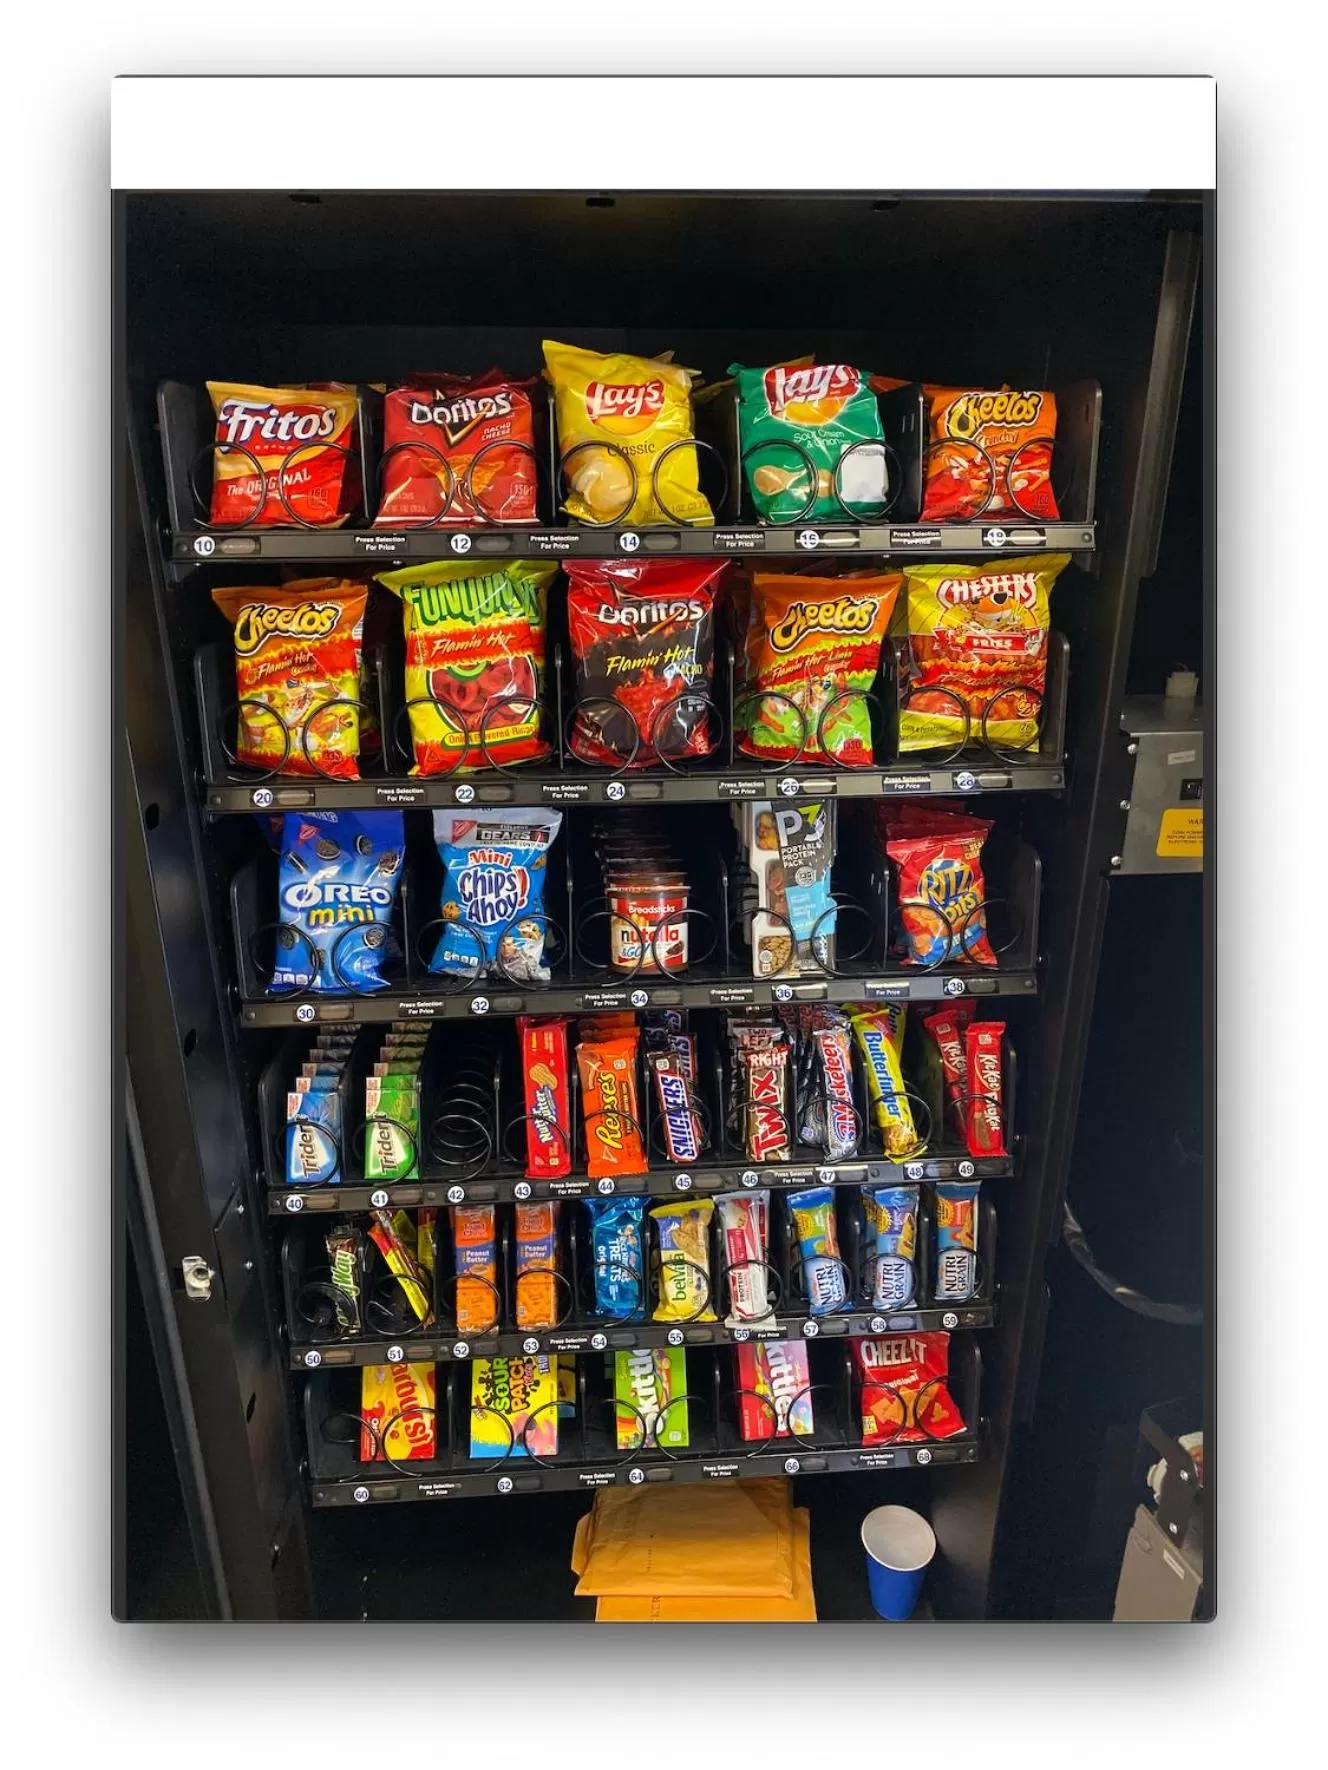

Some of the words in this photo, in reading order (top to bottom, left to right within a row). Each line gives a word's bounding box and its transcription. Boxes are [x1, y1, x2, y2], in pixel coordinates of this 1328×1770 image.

[588, 379, 664, 419] Lay's
[411, 393, 511, 425] Doritos
[947, 390, 1042, 439] Cheetos
[219, 400, 336, 450] Fritos
[484, 422, 511, 435] NACHO
[482, 429, 511, 441] CHEESE
[246, 469, 311, 494] ORGNAL
[196, 539, 212, 551] 10
[453, 538, 469, 550] 12
[622, 536, 638, 548] 14
[802, 533, 818, 545] 16
[938, 573, 1036, 607] CHESTER'S
[598, 600, 704, 625] Doritos
[234, 604, 339, 651] Cheetos
[772, 598, 878, 651] Cheetos
[431, 634, 484, 657] Flamin'
[486, 630, 516, 645] Hot
[294, 651, 312, 667] Hot
[606, 651, 664, 676] Flamin'
[664, 645, 696, 663] Hot
[448, 732, 472, 744] Onin
[474, 729, 510, 742] Fvored
[958, 775, 974, 787] 28
[457, 788, 473, 800] 22
[608, 785, 624, 797] 24
[782, 782, 798, 794] 26
[255, 791, 271, 803] 20
[776, 804, 826, 846] P3
[481, 830, 530, 840] GEARS
[781, 841, 823, 854] PORTABLE
[469, 850, 511, 868] Mini
[782, 850, 816, 861] PROTEIN
[784, 859, 804, 868] PACK
[459, 868, 517, 900] Chips
[920, 865, 974, 902] RITZ
[286, 884, 391, 908] OREO
[628, 903, 676, 914] Breadsticks
[309, 905, 374, 926] mini
[776, 986, 792, 998] 36
[948, 980, 964, 992] 38
[632, 992, 648, 1004] 34
[472, 999, 488, 1011] 32
[298, 1007, 314, 1019] 30
[750, 1052, 788, 1067] RIGHT
[822, 1034, 856, 1122] Msketeers
[863, 1032, 902, 1117] Butterfinger
[978, 1054, 1000, 1090] KitKat
[595, 1071, 623, 1149] Reese's
[752, 1070, 788, 1162] TWIX
[661, 1076, 696, 1158] SNICKERS
[532, 1108, 554, 1143] Nuttr
[296, 1114, 320, 1178] Trident
[374, 1112, 397, 1175] Trident
[908, 1166, 922, 1177] 48
[960, 1164, 974, 1174] 49
[676, 1177, 690, 1187] 45
[743, 1174, 757, 1184] 46
[820, 1171, 834, 1181] 47
[516, 1185, 530, 1196] 43
[599, 1181, 613, 1191] 44
[372, 1193, 386, 1204] 41
[449, 1189, 463, 1199] 42
[287, 1198, 301, 1208] 40
[597, 1245, 607, 1277] origal
[331, 1250, 357, 1286] Way
[945, 1256, 956, 1292] NUTRI
[957, 1255, 967, 1292] GRAIN
[672, 1252, 687, 1301] belVita
[882, 1263, 894, 1300] NUTRI
[894, 1262, 905, 1300] GRAIN
[816, 1266, 829, 1306] NUTRI
[828, 1265, 844, 1303] GRAIN
[872, 1319, 886, 1330] 58
[944, 1316, 958, 1326] 59
[804, 1324, 818, 1334] 57
[592, 1336, 606, 1347] 54
[668, 1332, 682, 1342] 55
[454, 1345, 468, 1355] 52
[524, 1340, 538, 1351] 53
[306, 1354, 320, 1364] 50
[388, 1348, 402, 1359] 51
[492, 1357, 510, 1411] SOUR
[764, 1342, 798, 1432] kittles
[628, 1349, 664, 1438] Skittl
[917, 1452, 931, 1462] 68
[785, 1460, 799, 1471] 66
[630, 1471, 644, 1481] 64
[498, 1480, 512, 1490] 62
[354, 1489, 368, 1500] 60
